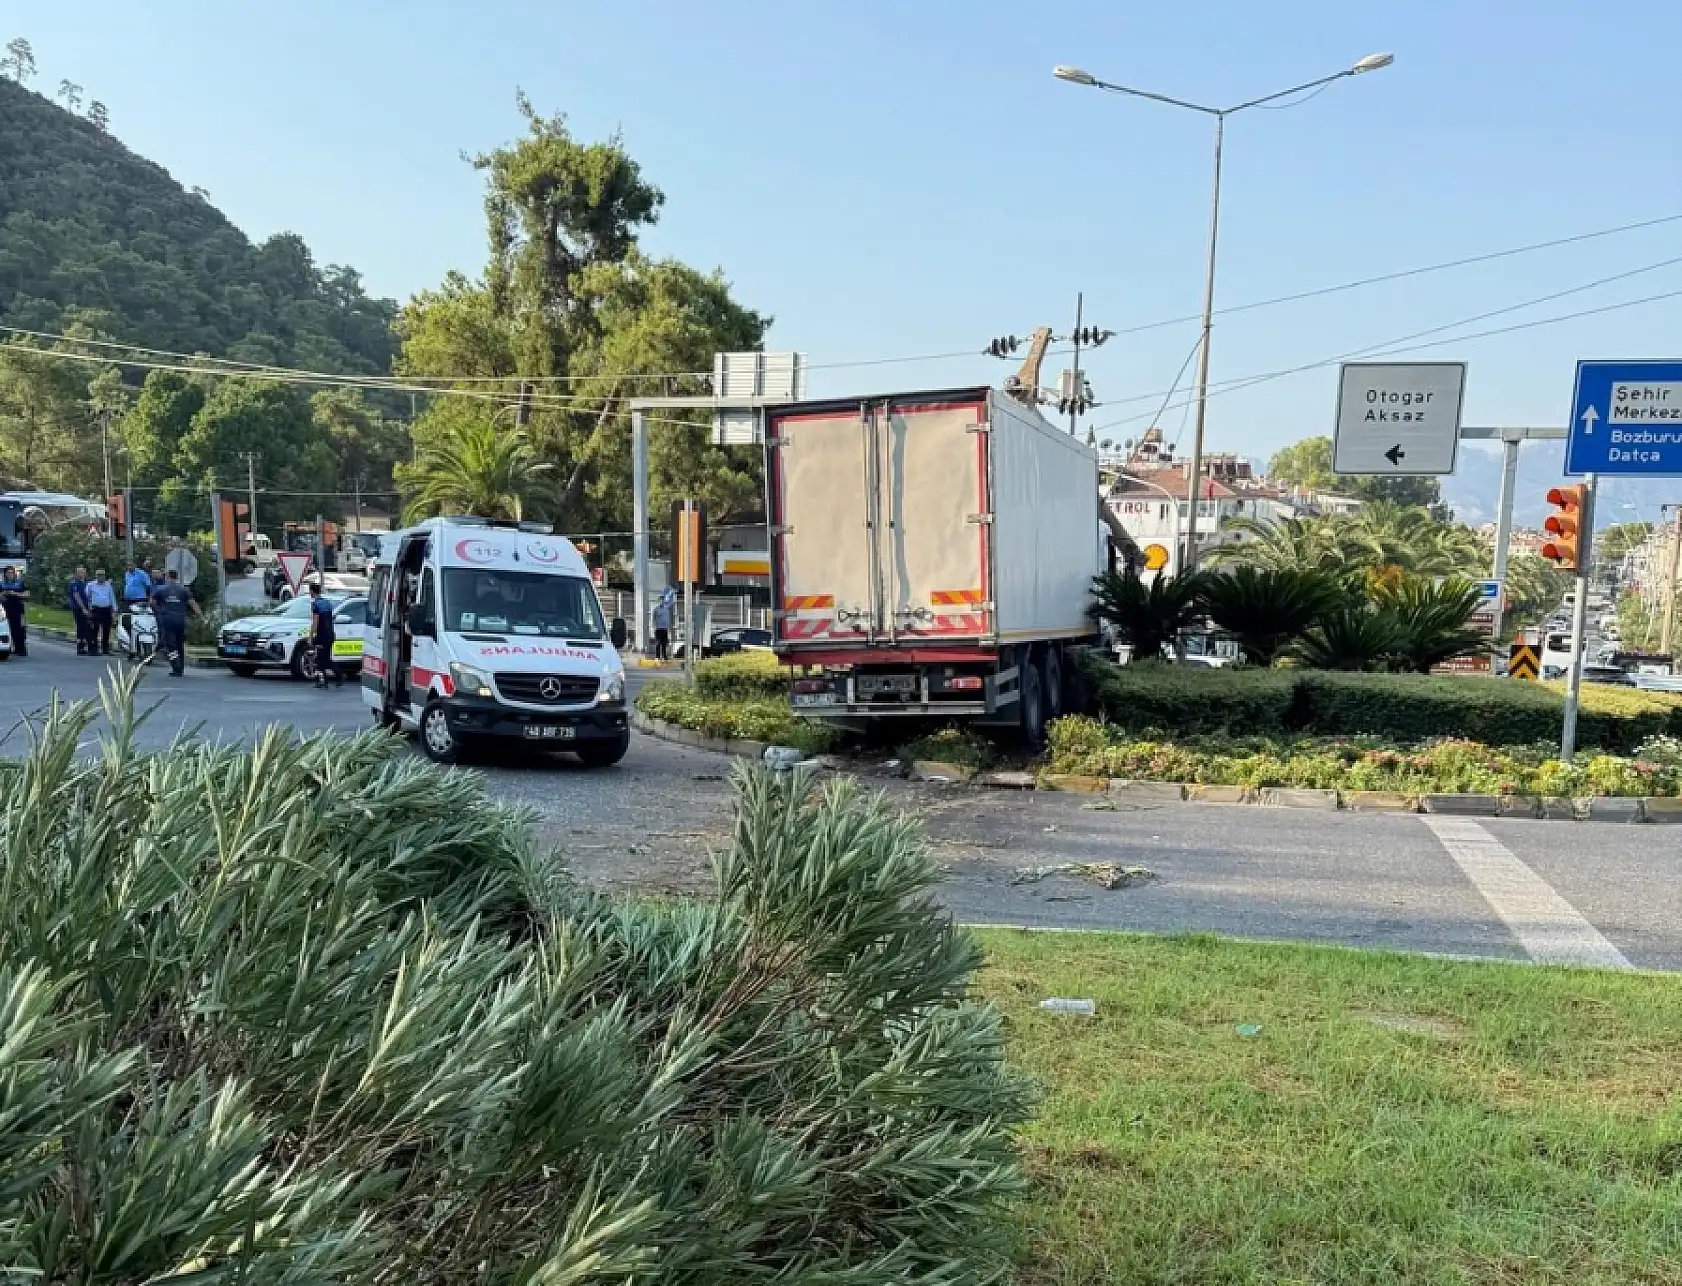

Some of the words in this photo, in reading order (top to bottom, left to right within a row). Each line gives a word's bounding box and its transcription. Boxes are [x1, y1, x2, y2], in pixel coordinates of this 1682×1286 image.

[1366, 389, 1434, 405] Otogar
[1617, 386, 1671, 403] Şehir
[1365, 408, 1425, 422] Aksaz
[1609, 448, 1660, 463] Datça
